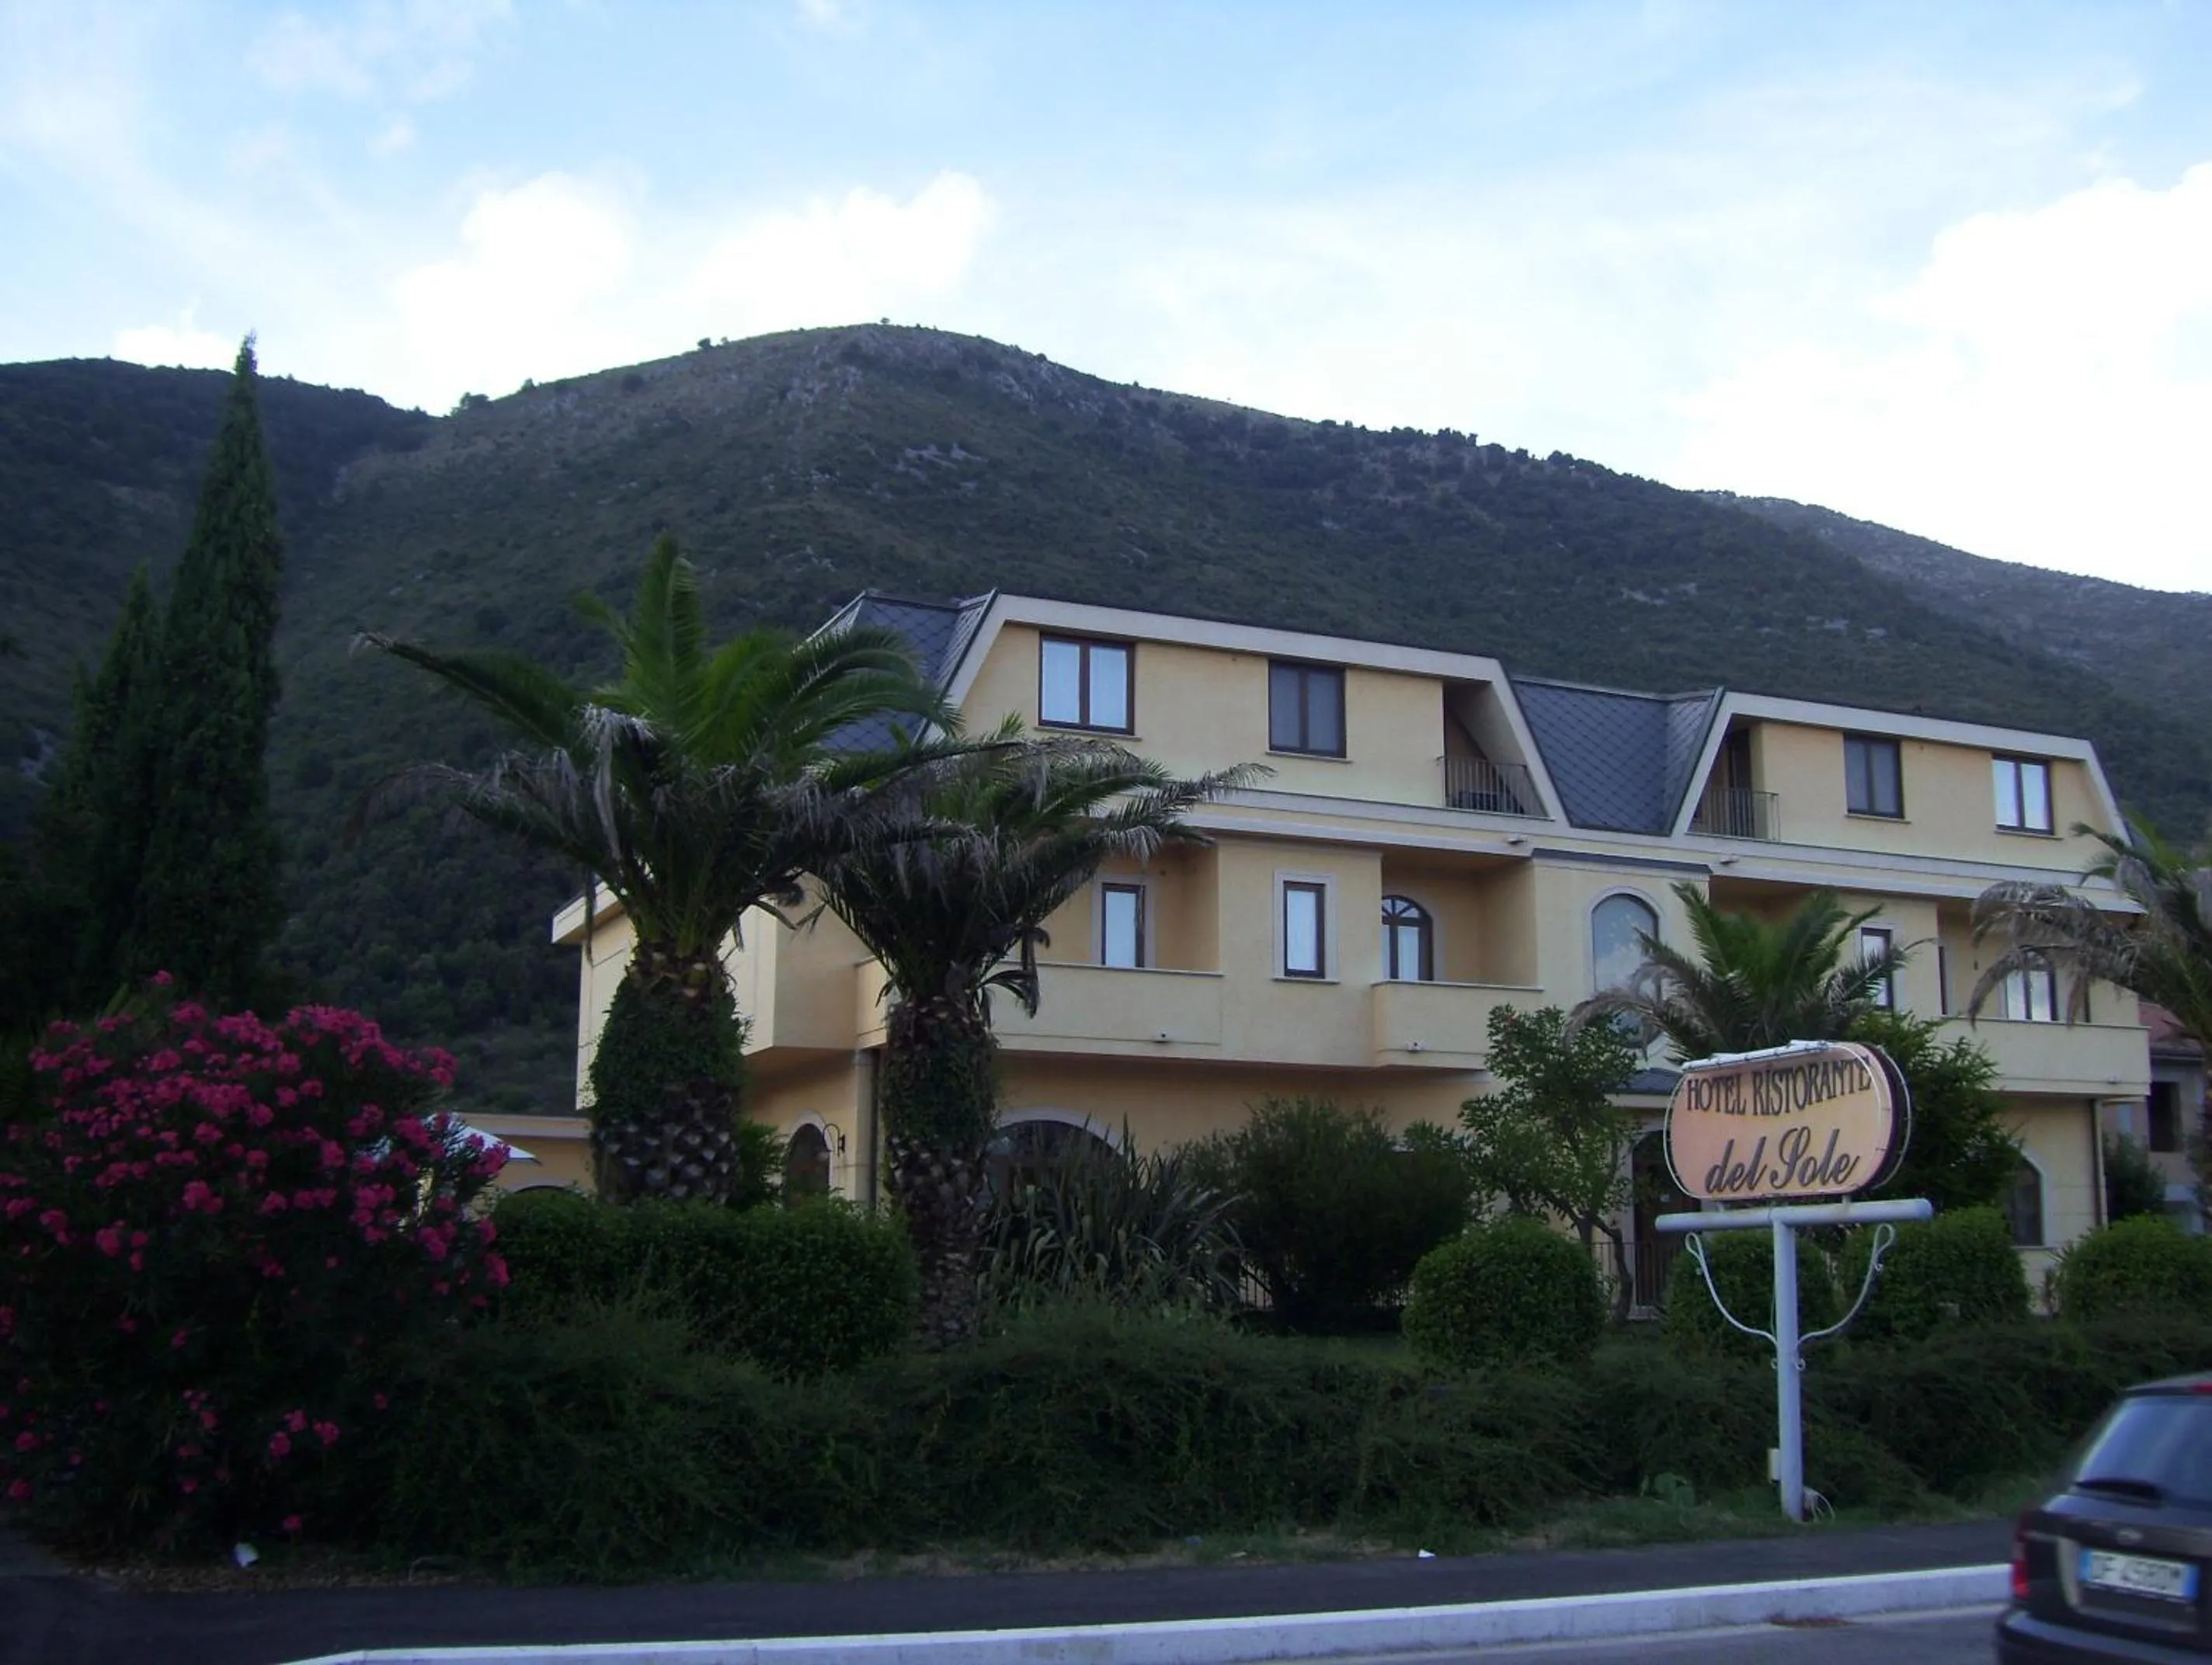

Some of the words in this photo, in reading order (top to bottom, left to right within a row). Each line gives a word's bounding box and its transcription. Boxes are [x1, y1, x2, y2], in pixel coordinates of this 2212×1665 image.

[1686, 1073, 1747, 1115] HOTEL
[1752, 1055, 1872, 1116] RISTORANTE
[1705, 1136, 1767, 1194] del
[1769, 1126, 1860, 1190] Sole
